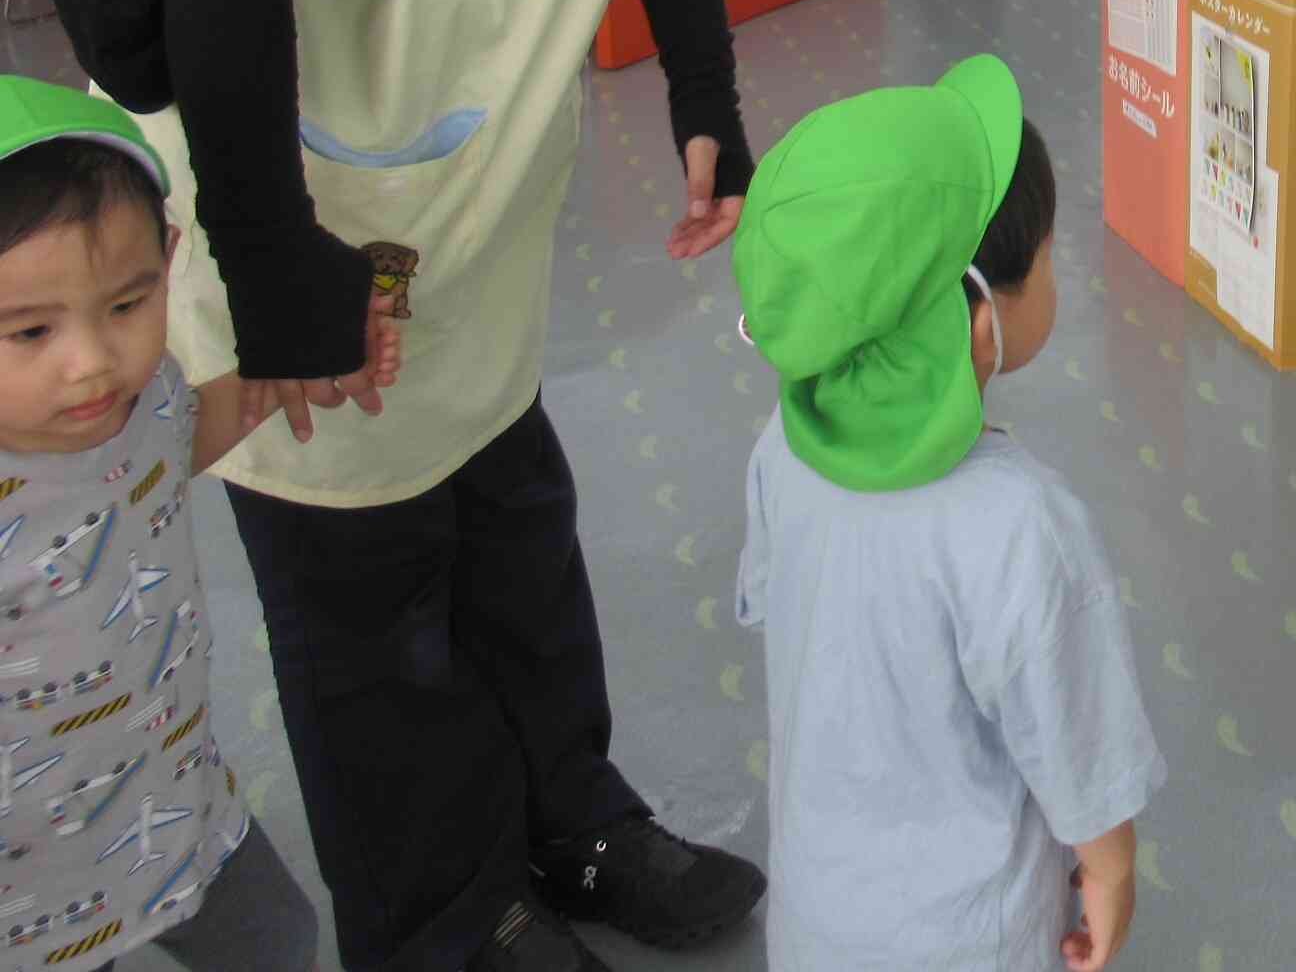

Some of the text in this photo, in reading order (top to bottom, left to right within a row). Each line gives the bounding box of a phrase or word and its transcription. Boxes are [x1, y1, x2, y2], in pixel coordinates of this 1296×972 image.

[1108, 53, 1176, 118] お名前シール
